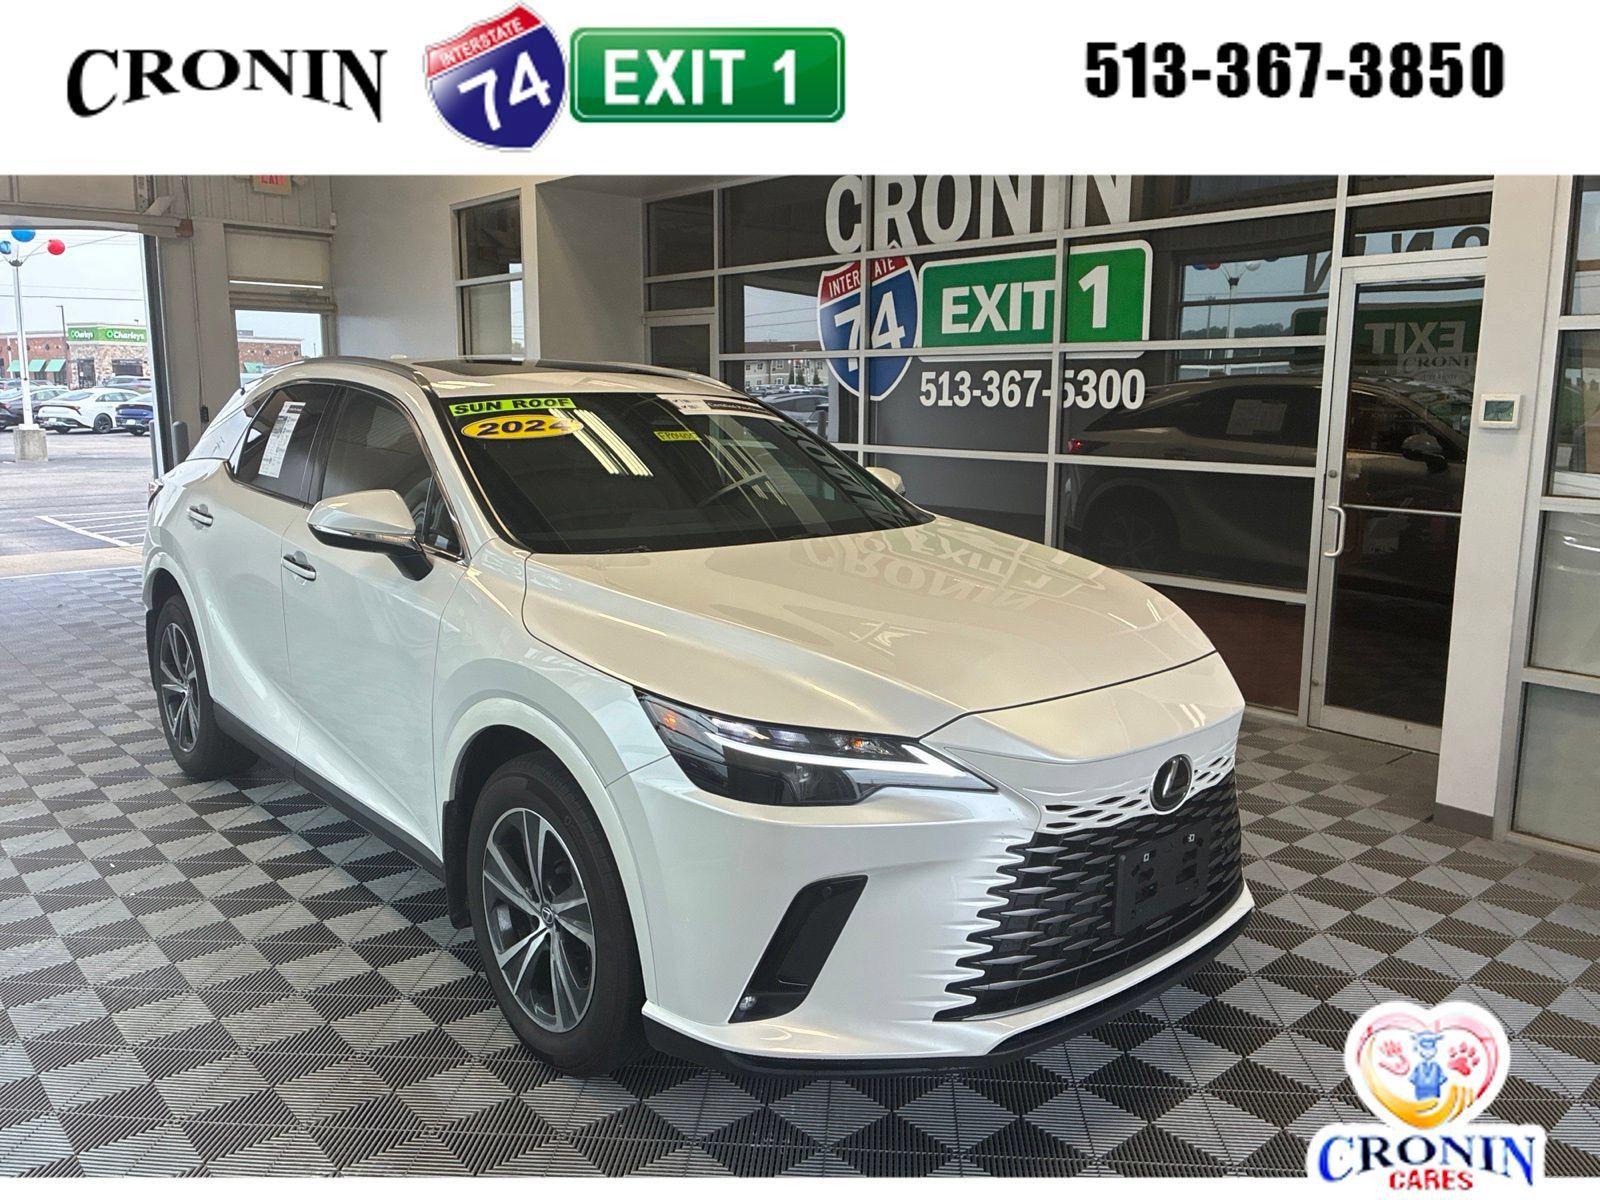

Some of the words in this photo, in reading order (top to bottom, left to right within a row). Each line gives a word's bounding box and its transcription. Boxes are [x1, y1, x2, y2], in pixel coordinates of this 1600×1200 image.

[825, 174, 1132, 255] CRONIN
[828, 258, 896, 298] INTERATE
[941, 279, 1056, 335] EXIT
[1078, 264, 1110, 329] 1
[834, 290, 906, 373] 74
[454, 401, 502, 415] SUN
[511, 398, 571, 409] ROOF
[919, 368, 1146, 410] 513-367-5300
